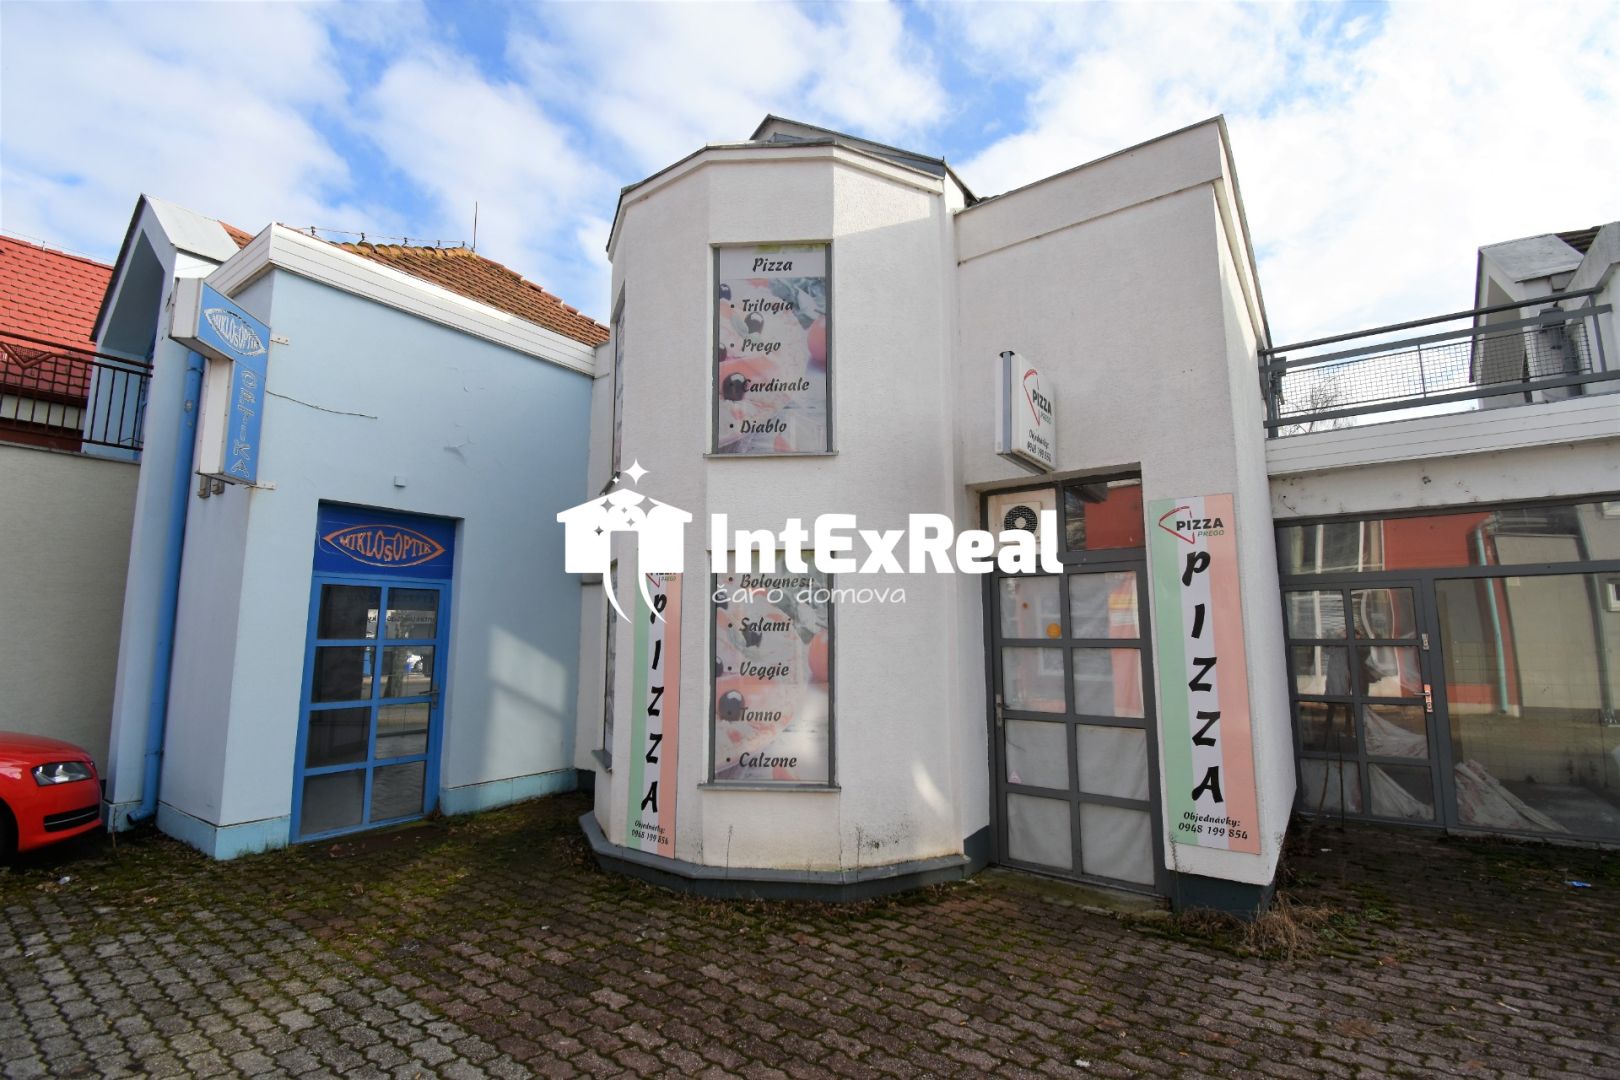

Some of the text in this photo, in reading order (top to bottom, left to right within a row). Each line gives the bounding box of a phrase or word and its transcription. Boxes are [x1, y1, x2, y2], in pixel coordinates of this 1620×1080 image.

[752, 257, 793, 273] Pizza
[741, 298, 794, 315] Trilogia
[741, 338, 782, 355] Prego
[743, 377, 810, 393] Cardinale
[1032, 389, 1052, 416] PIZZA
[740, 418, 787, 434] Diablo
[1176, 518, 1224, 531] PIZZA
[1197, 529, 1225, 537] PREGO
[740, 617, 791, 632] Salami
[740, 661, 789, 680] Veggie
[1181, 551, 1224, 803] PIZZA
[641, 594, 667, 813] PIZZA
[740, 707, 782, 722] Tonno
[739, 752, 798, 768] Calzone
[1183, 811, 1241, 828] Objednávky:
[1178, 822, 1248, 840] 0948 199 854
